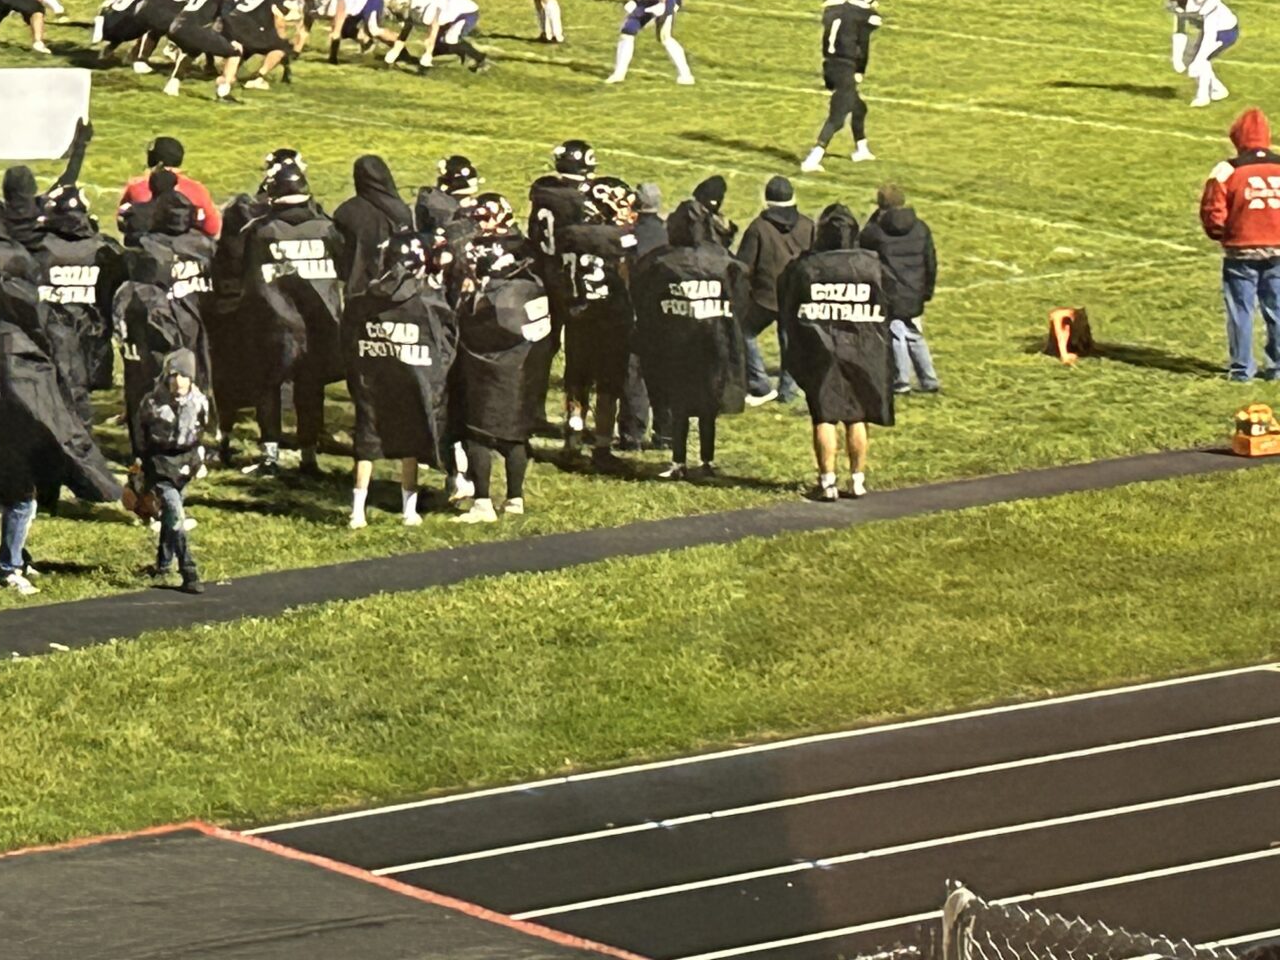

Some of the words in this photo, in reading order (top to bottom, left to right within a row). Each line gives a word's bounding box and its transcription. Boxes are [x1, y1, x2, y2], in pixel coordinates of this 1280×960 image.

[811, 283, 870, 302] COZAD
[798, 303, 886, 322] FOOTBALL
[366, 321, 419, 344] COZAD
